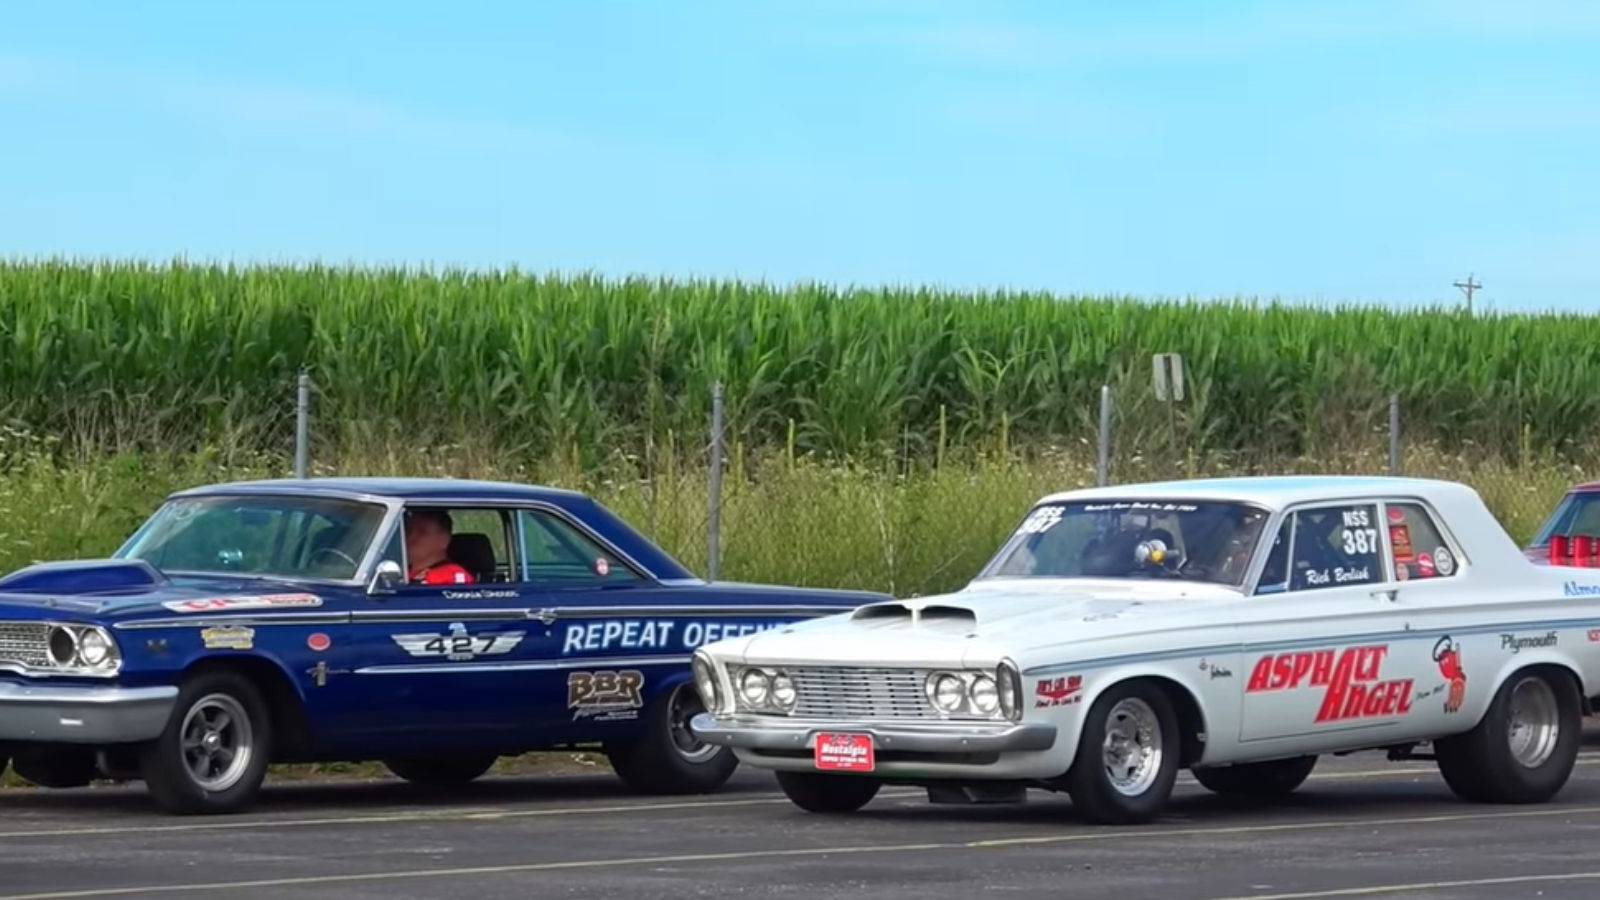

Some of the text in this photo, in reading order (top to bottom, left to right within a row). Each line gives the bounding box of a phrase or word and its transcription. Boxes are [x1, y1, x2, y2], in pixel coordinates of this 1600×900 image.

[1342, 511, 1369, 526] NSS
[1342, 529, 1376, 555] 387
[1305, 569, 1330, 584] Rich
[425, 636, 498, 653] 427
[563, 621, 785, 653] REPEAT OFF
[1501, 631, 1558, 654] Plymouth
[1246, 645, 1388, 692] ASPHALT
[567, 669, 645, 708] BBR
